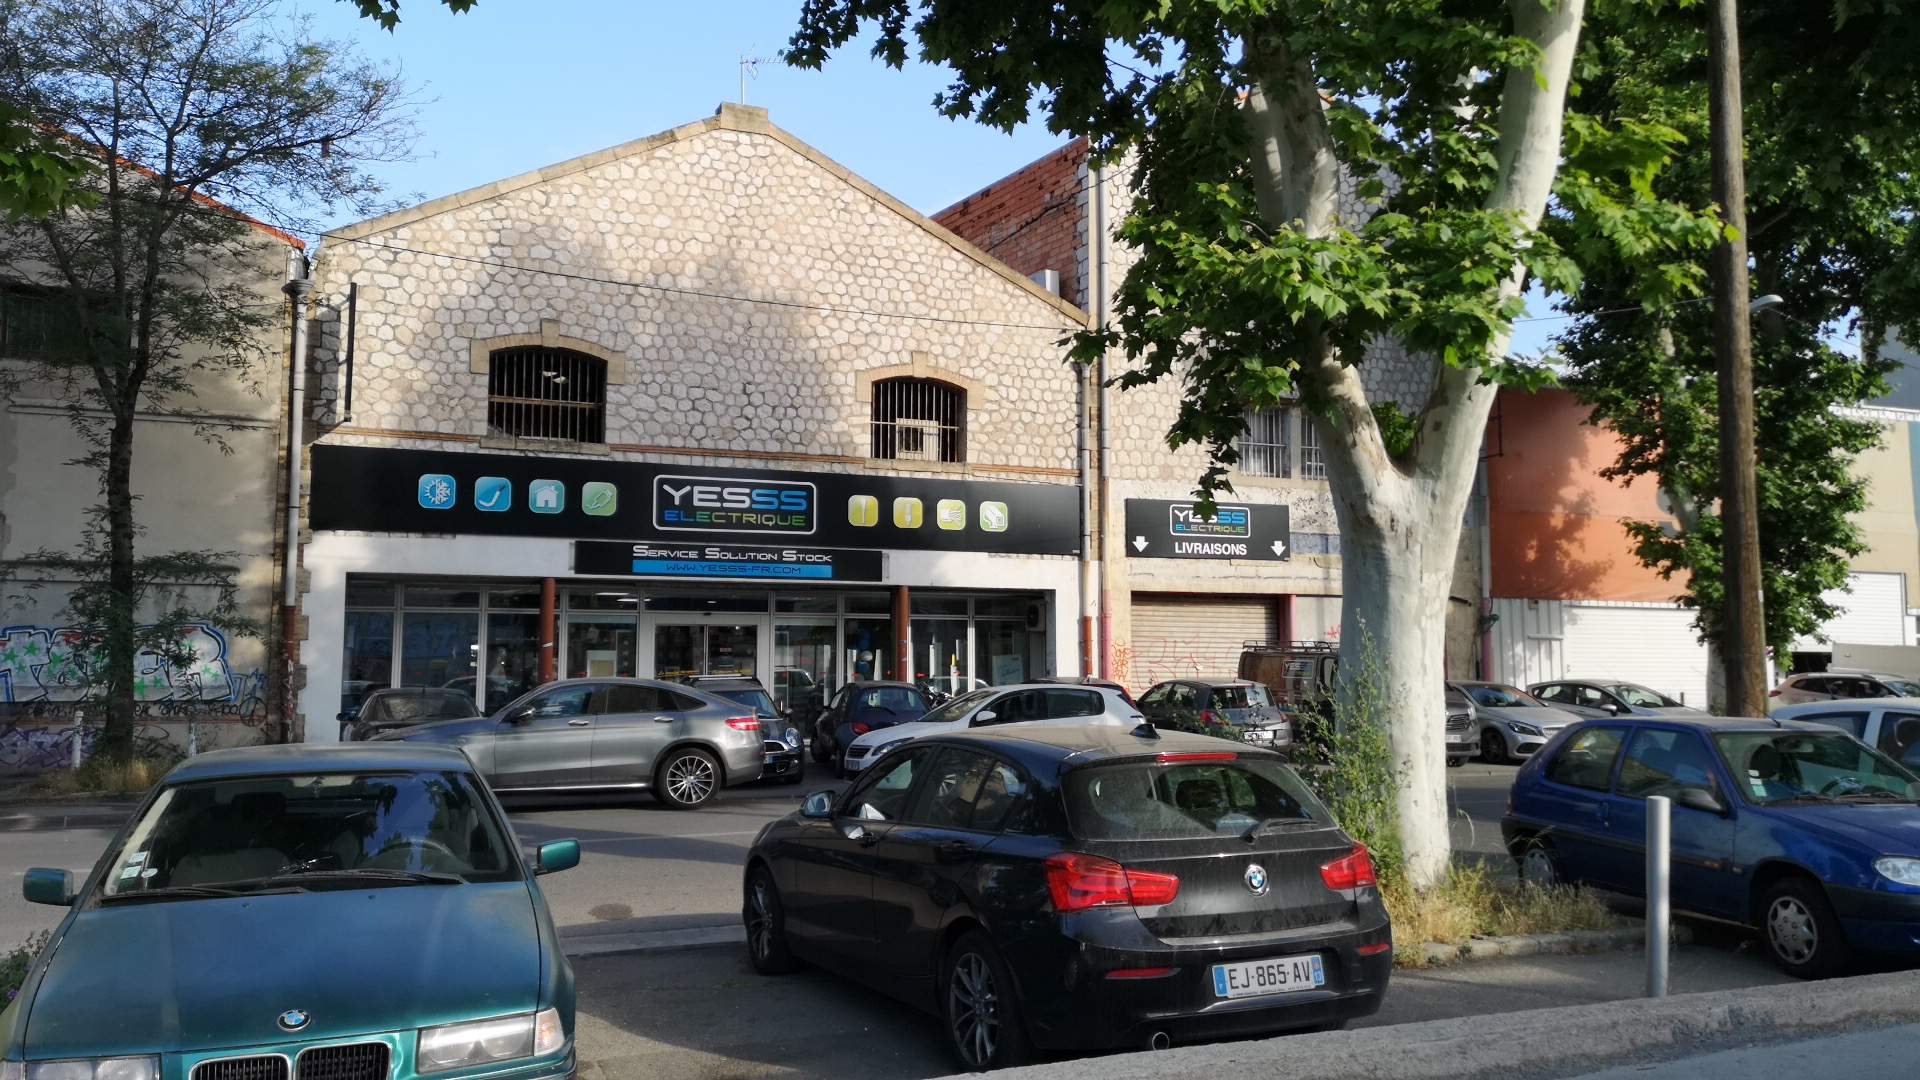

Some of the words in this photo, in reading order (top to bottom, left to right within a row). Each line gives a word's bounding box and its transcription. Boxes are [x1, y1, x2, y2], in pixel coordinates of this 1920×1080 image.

[662, 484, 807, 511] YESSS
[664, 510, 806, 527] ELECTRIQUE
[1175, 523, 1246, 534] ELECTRIQUE
[632, 545, 699, 559] SERVICE
[704, 547, 778, 561] SOLUTION
[782, 550, 833, 562] STOCK
[1174, 541, 1248, 556] LIVRAISONS
